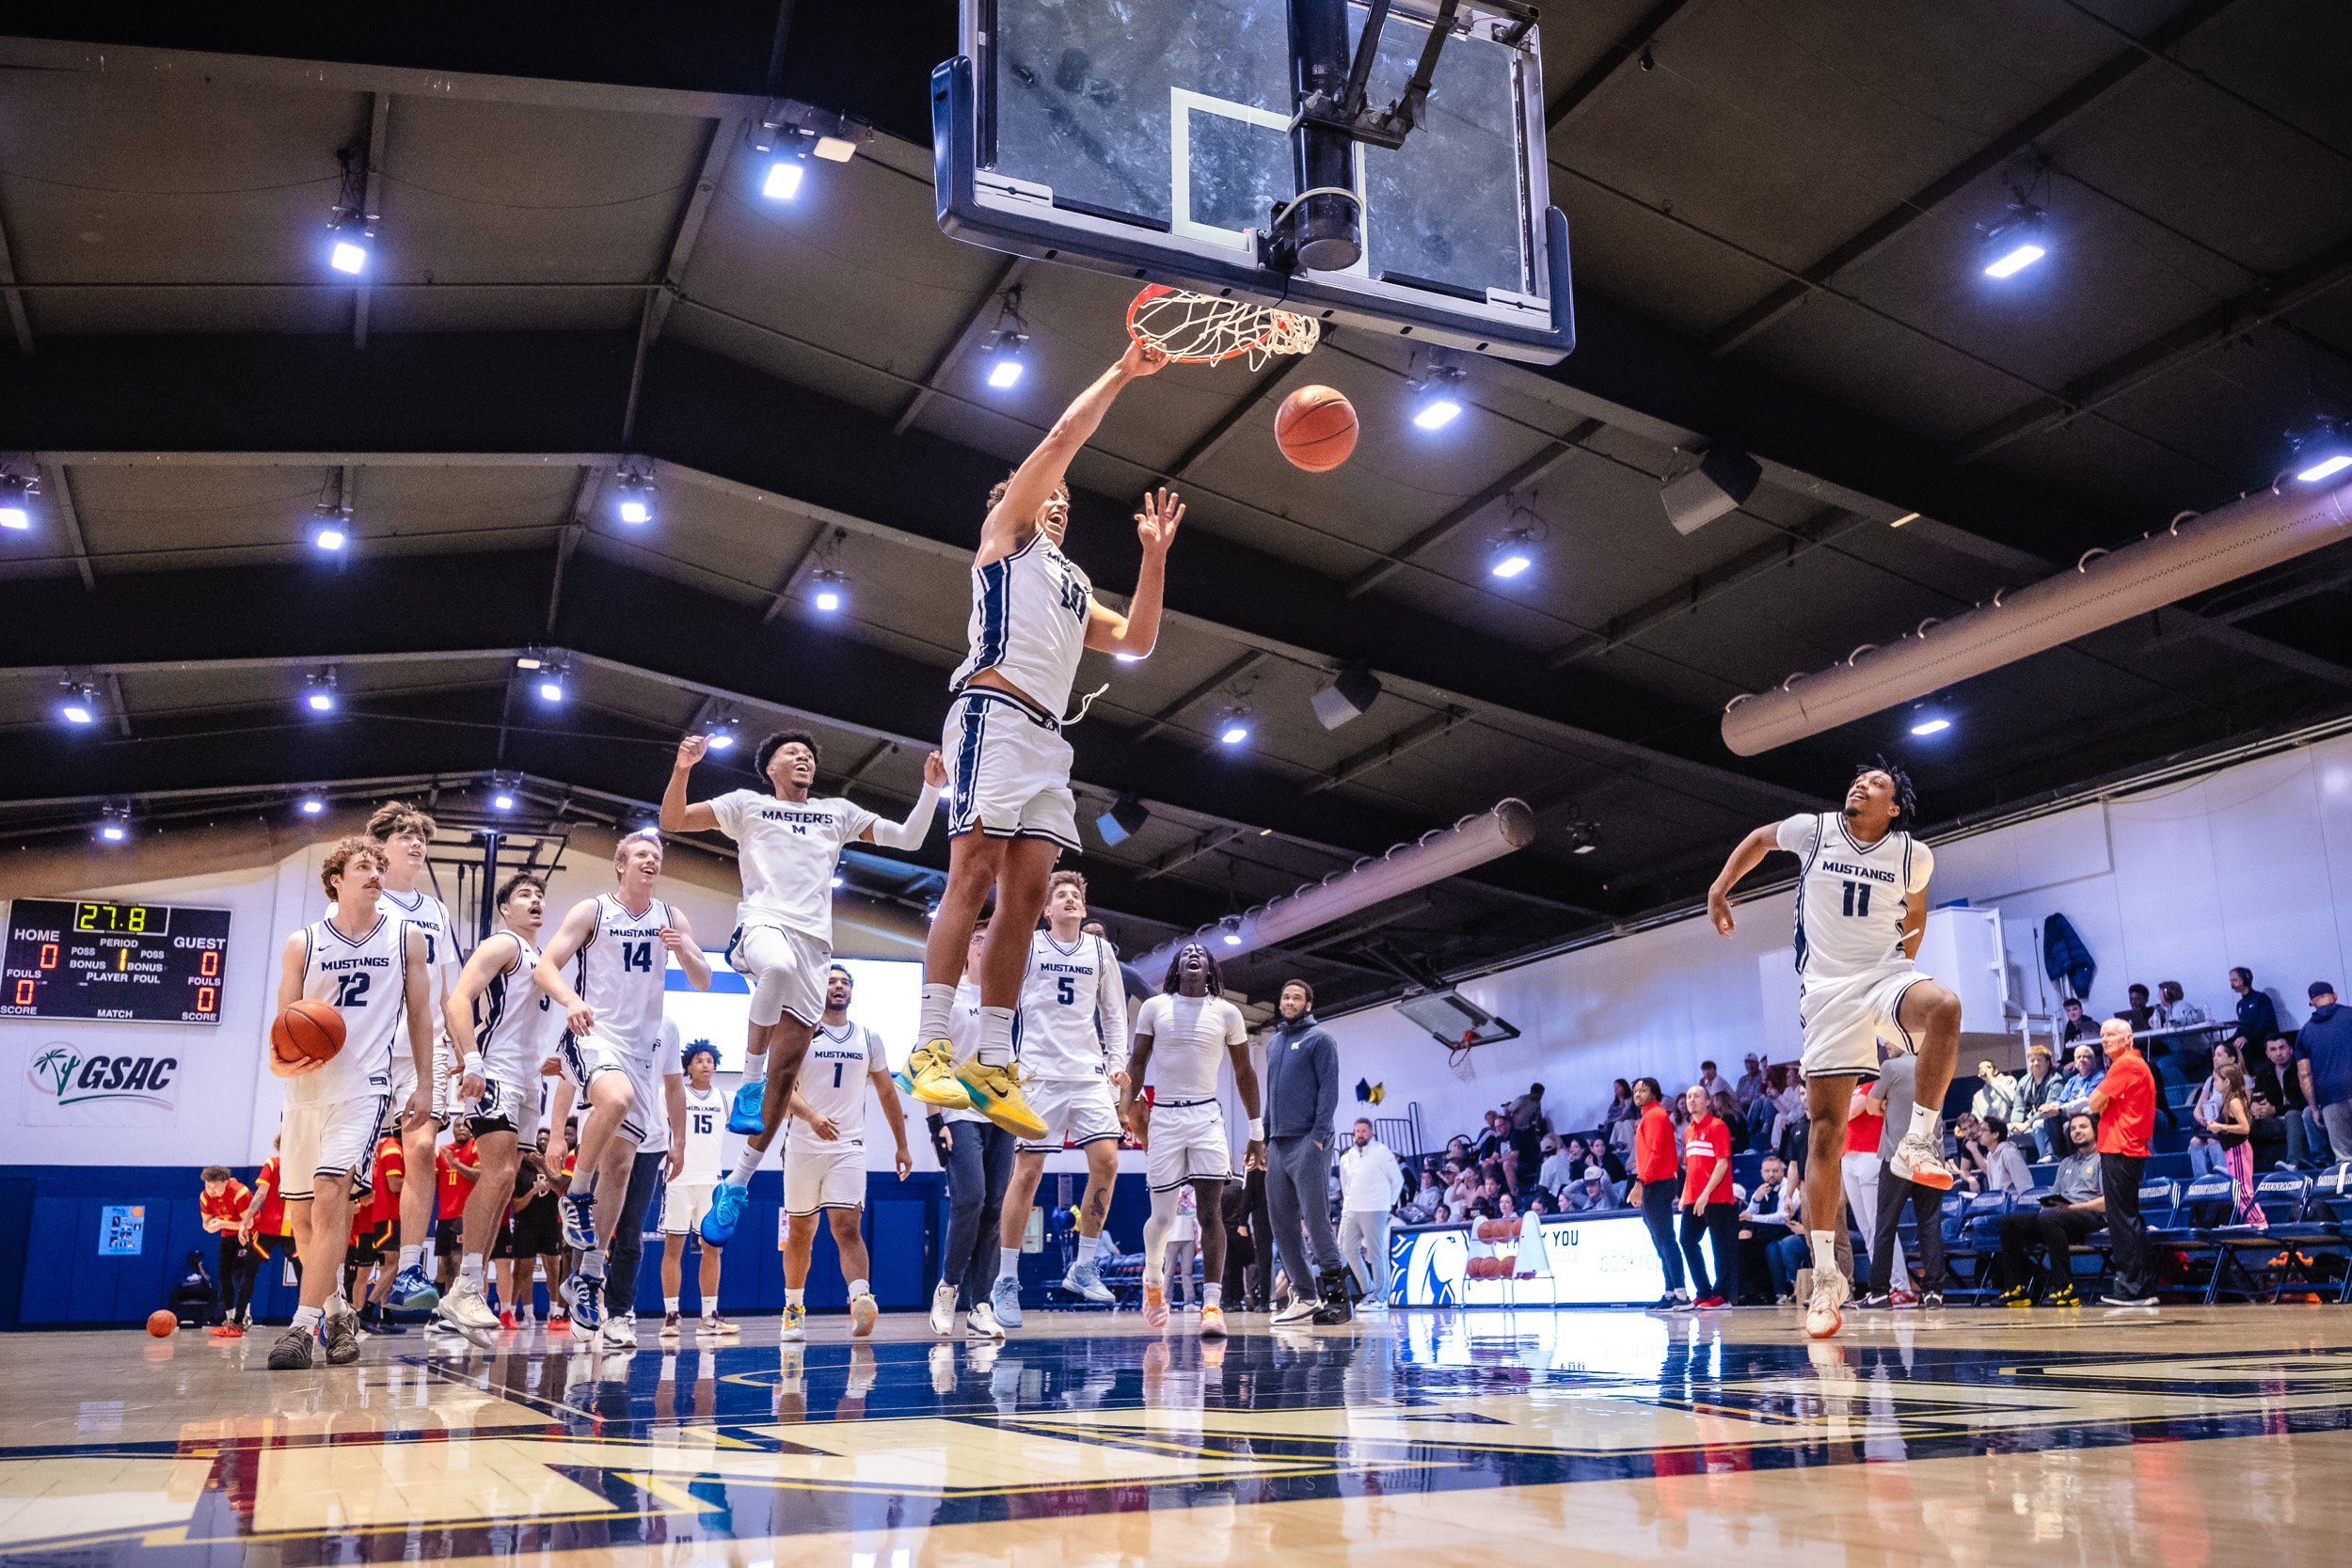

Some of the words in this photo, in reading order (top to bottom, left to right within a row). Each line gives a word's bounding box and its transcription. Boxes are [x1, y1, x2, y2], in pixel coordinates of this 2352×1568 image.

[1061, 573, 1088, 625] 10
[762, 810, 834, 824] MASTER'S
[791, 824, 806, 835] M
[1822, 860, 1896, 882] MUSTANGS
[1842, 879, 1872, 917] 11
[80, 904, 147, 932] 27.8
[14, 928, 61, 942] HOME
[610, 928, 661, 938] MUSTANG
[100, 938, 139, 948] PERIOD
[173, 936, 227, 950] GUEST
[40, 943, 59, 969] 0
[71, 946, 96, 957] POSS
[140, 949, 165, 959] POSS
[622, 942, 653, 973] 14
[70, 959, 106, 970] BONUS
[119, 947, 128, 972] 1
[127, 961, 164, 972] BONUS
[200, 951, 219, 976] 0
[321, 957, 389, 971] MUSTANGS
[7, 969, 41, 978] FOULS
[1041, 962, 1093, 975] MUSTANGS
[86, 972, 128, 982] PLAYER
[133, 974, 161, 984] FOUL
[188, 976, 221, 986] FOULS
[15, 979, 35, 1006] 0
[333, 972, 371, 1007] 12
[1057, 976, 1074, 1006] 5
[197, 987, 215, 1012] 0
[0, 1006, 38, 1015] SCORE
[97, 1008, 133, 1019] MATCH
[182, 1012, 216, 1022] SCORE
[814, 1051, 864, 1060] MUSTANGS
[77, 1055, 178, 1090] GSAC
[834, 1062, 844, 1088] 1
[693, 1114, 712, 1134] 15
[1552, 1229, 1579, 1247] YOU
